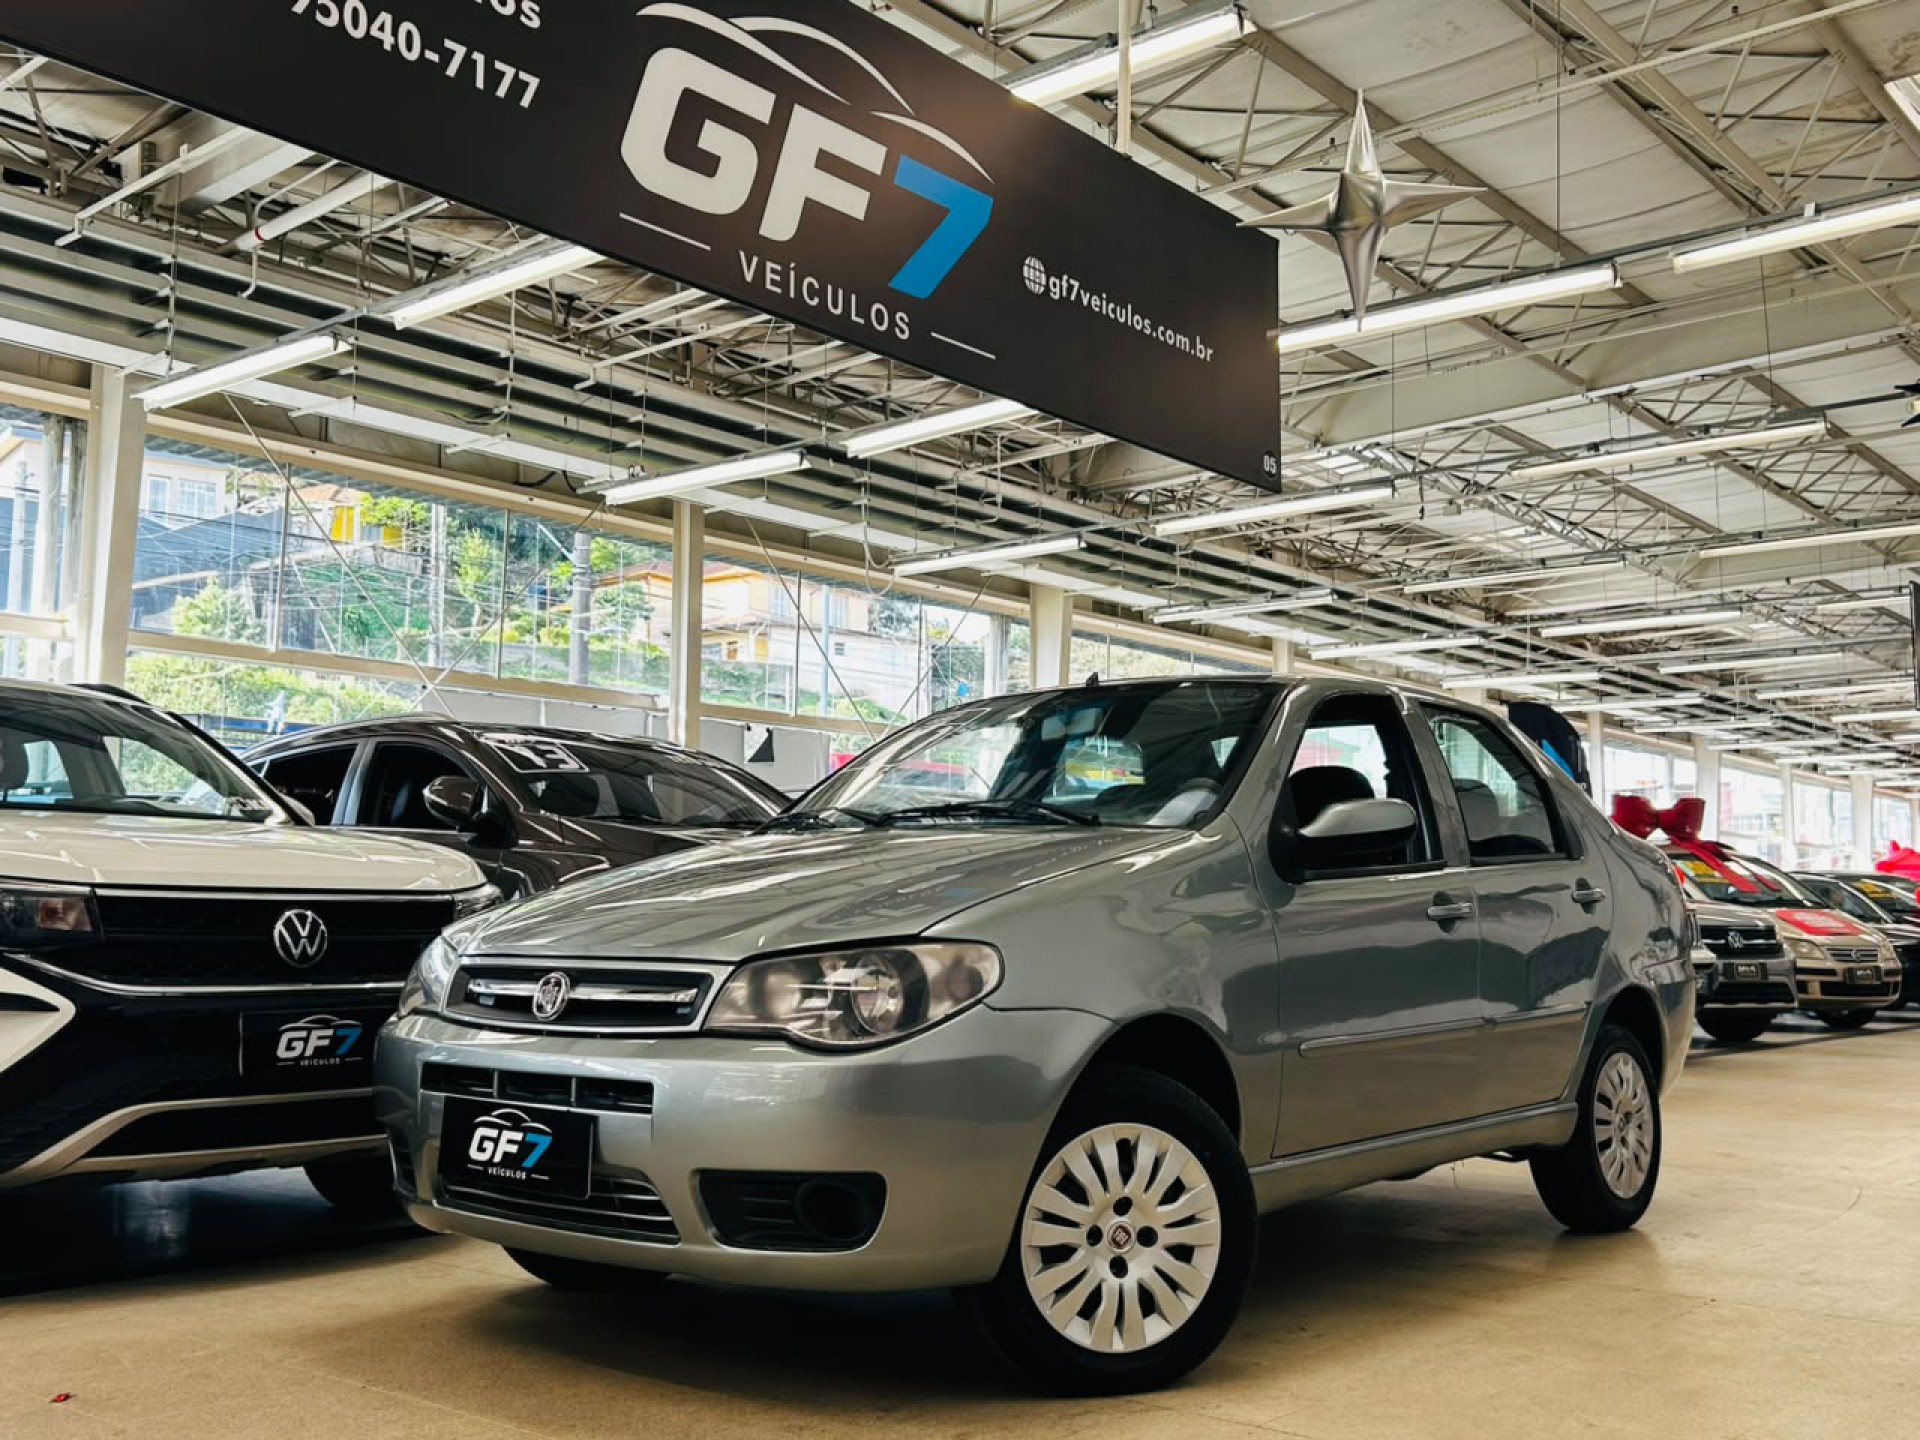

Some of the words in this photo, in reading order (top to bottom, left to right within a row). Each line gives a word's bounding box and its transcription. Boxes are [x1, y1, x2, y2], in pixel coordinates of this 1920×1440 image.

[620, 47, 994, 299] GF7
[739, 250, 911, 340] VEÍCULOS
[1049, 274, 1214, 362] gf7veiculos.com.br
[1263, 454, 1277, 475] 05
[276, 1027, 362, 1059] GF7
[468, 1127, 553, 1168] GF7
